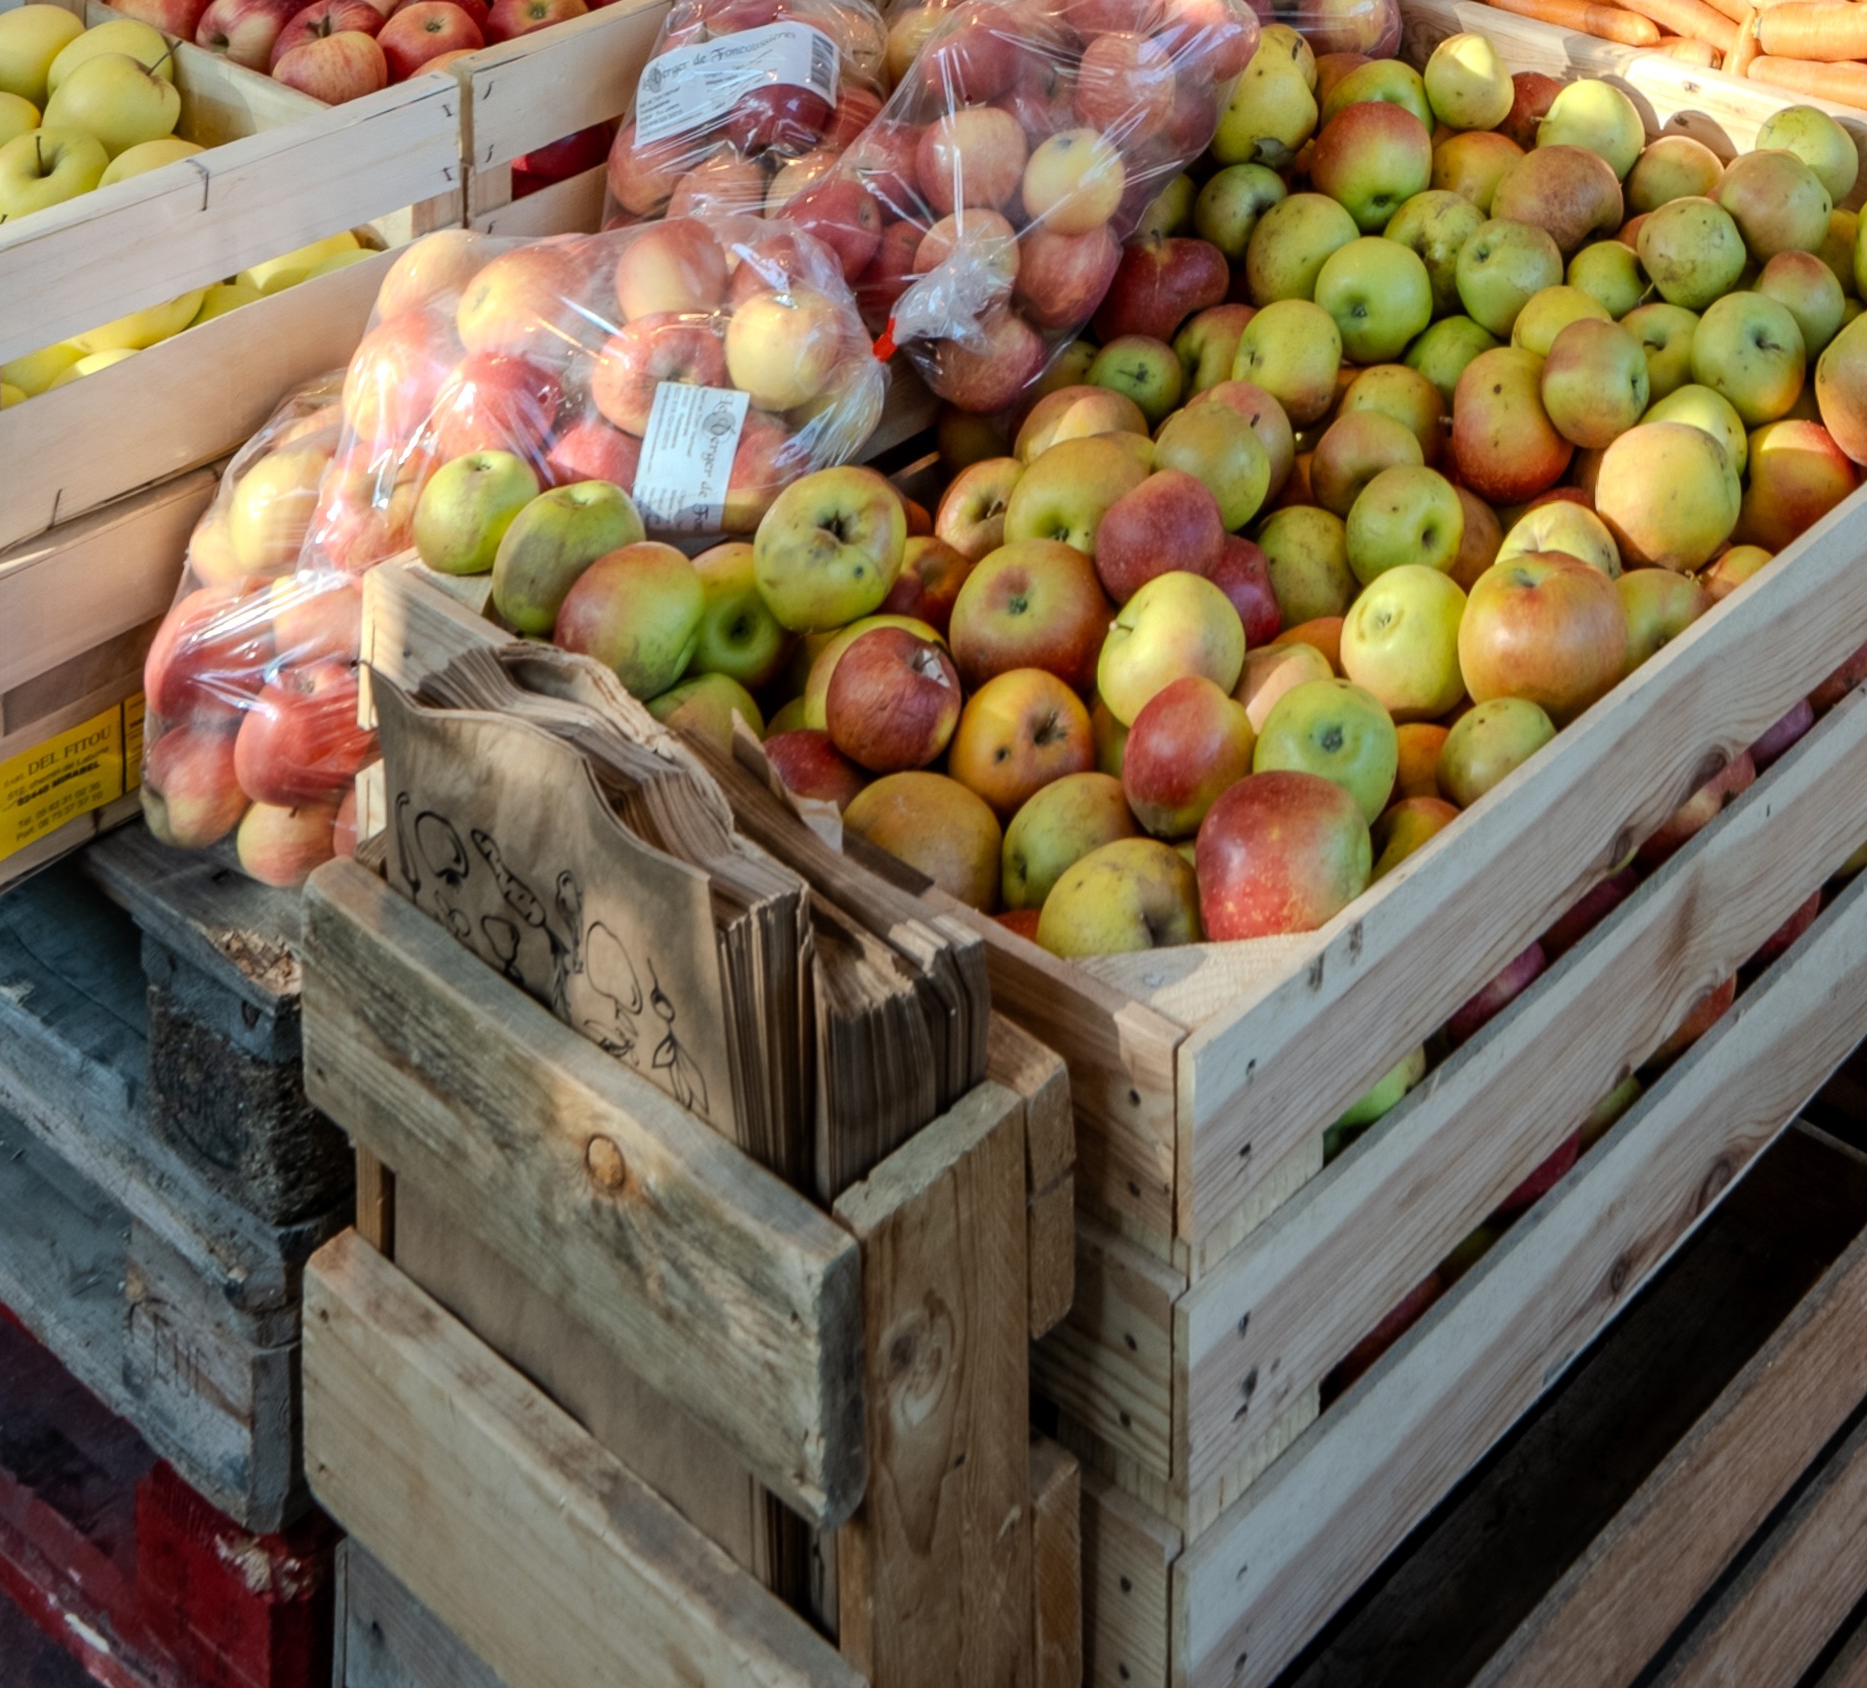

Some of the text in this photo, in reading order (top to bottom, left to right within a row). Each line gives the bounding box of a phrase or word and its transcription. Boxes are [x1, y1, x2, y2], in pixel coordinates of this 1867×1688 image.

[27, 725, 112, 776] DEL FITOU
[52, 762, 100, 790] MIRABEL
